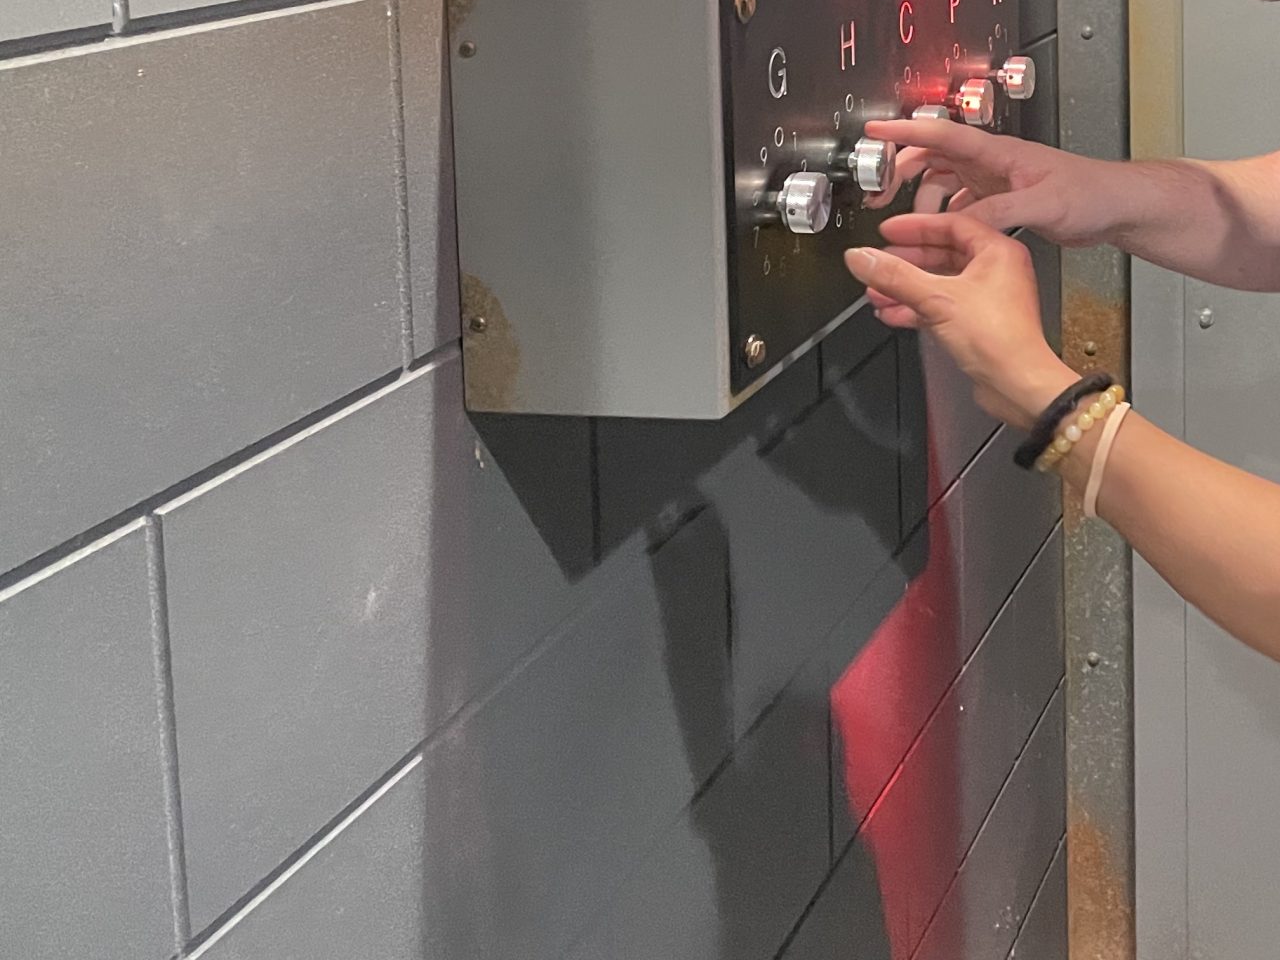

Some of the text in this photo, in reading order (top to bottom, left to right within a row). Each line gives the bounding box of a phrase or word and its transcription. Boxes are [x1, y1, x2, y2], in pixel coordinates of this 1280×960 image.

[768, 46, 788, 99] G
[840, 20, 856, 71] H
[900, 1, 914, 44] C
[774, 126, 785, 147] 0
